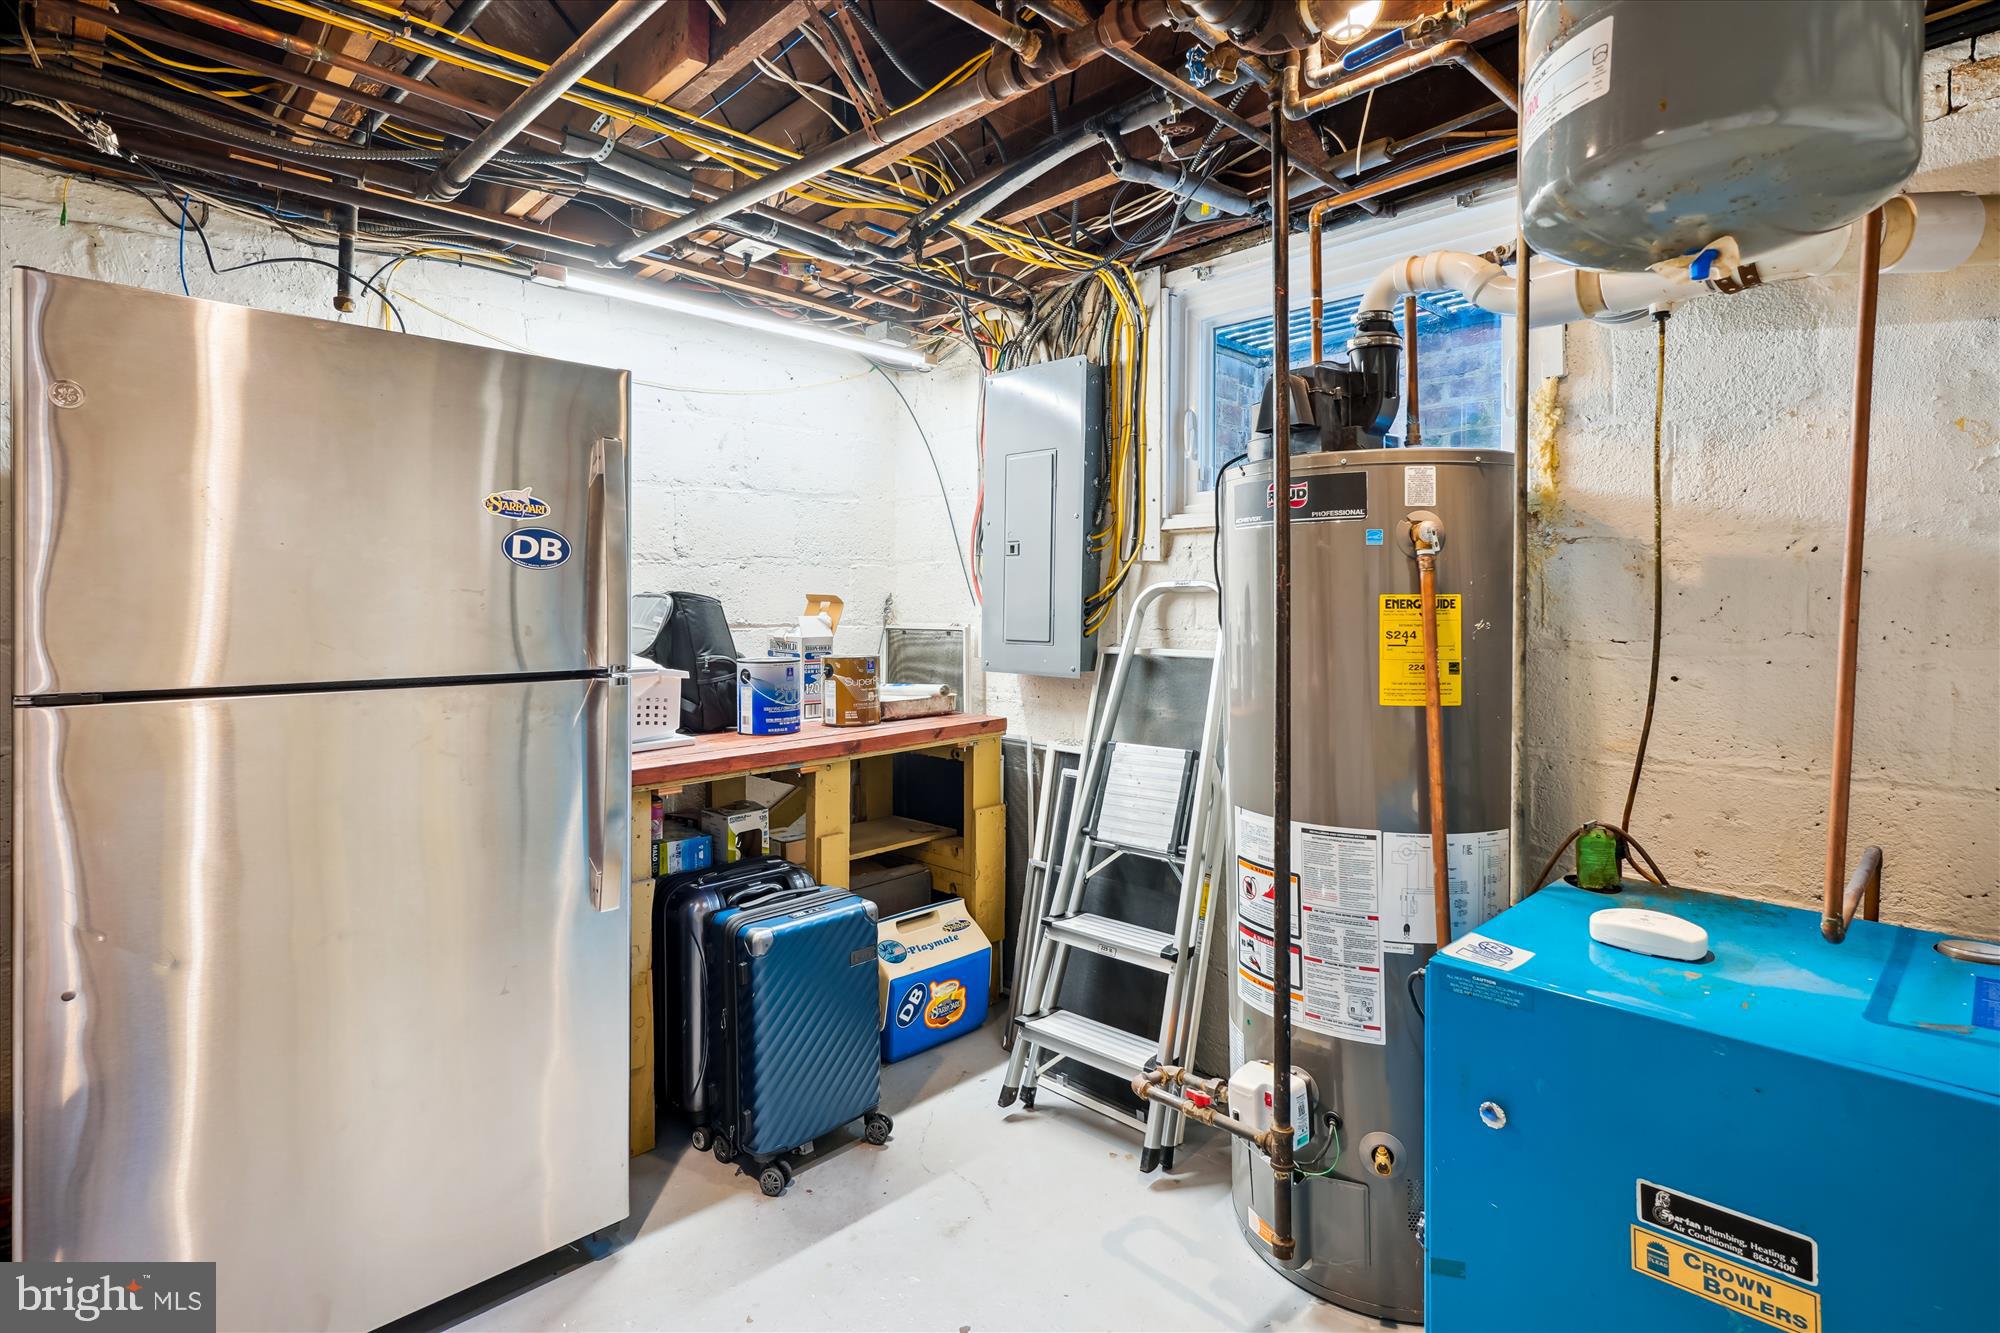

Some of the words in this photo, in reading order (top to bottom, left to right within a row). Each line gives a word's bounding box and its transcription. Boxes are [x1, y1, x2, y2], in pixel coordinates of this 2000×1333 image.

[1311, 509, 1365, 518] PROFESSIONAL
[511, 535, 563, 561] DB
[907, 934, 959, 954] Playmate
[1472, 975, 1497, 986] CAUTION
[899, 988, 923, 1022] DB
[1660, 1209, 1702, 1231] Spartan
[1704, 1225, 1748, 1248] Plumbing,
[1750, 1242, 1787, 1263] Heating
[1790, 1257, 1799, 1266] &
[1672, 1223, 1686, 1234] Air
[1687, 1229, 1744, 1256] Conditioning
[1752, 1252, 1796, 1274] 864-7400
[1683, 1252, 1772, 1298] CROWN
[1703, 1275, 1809, 1331] BOILERS
